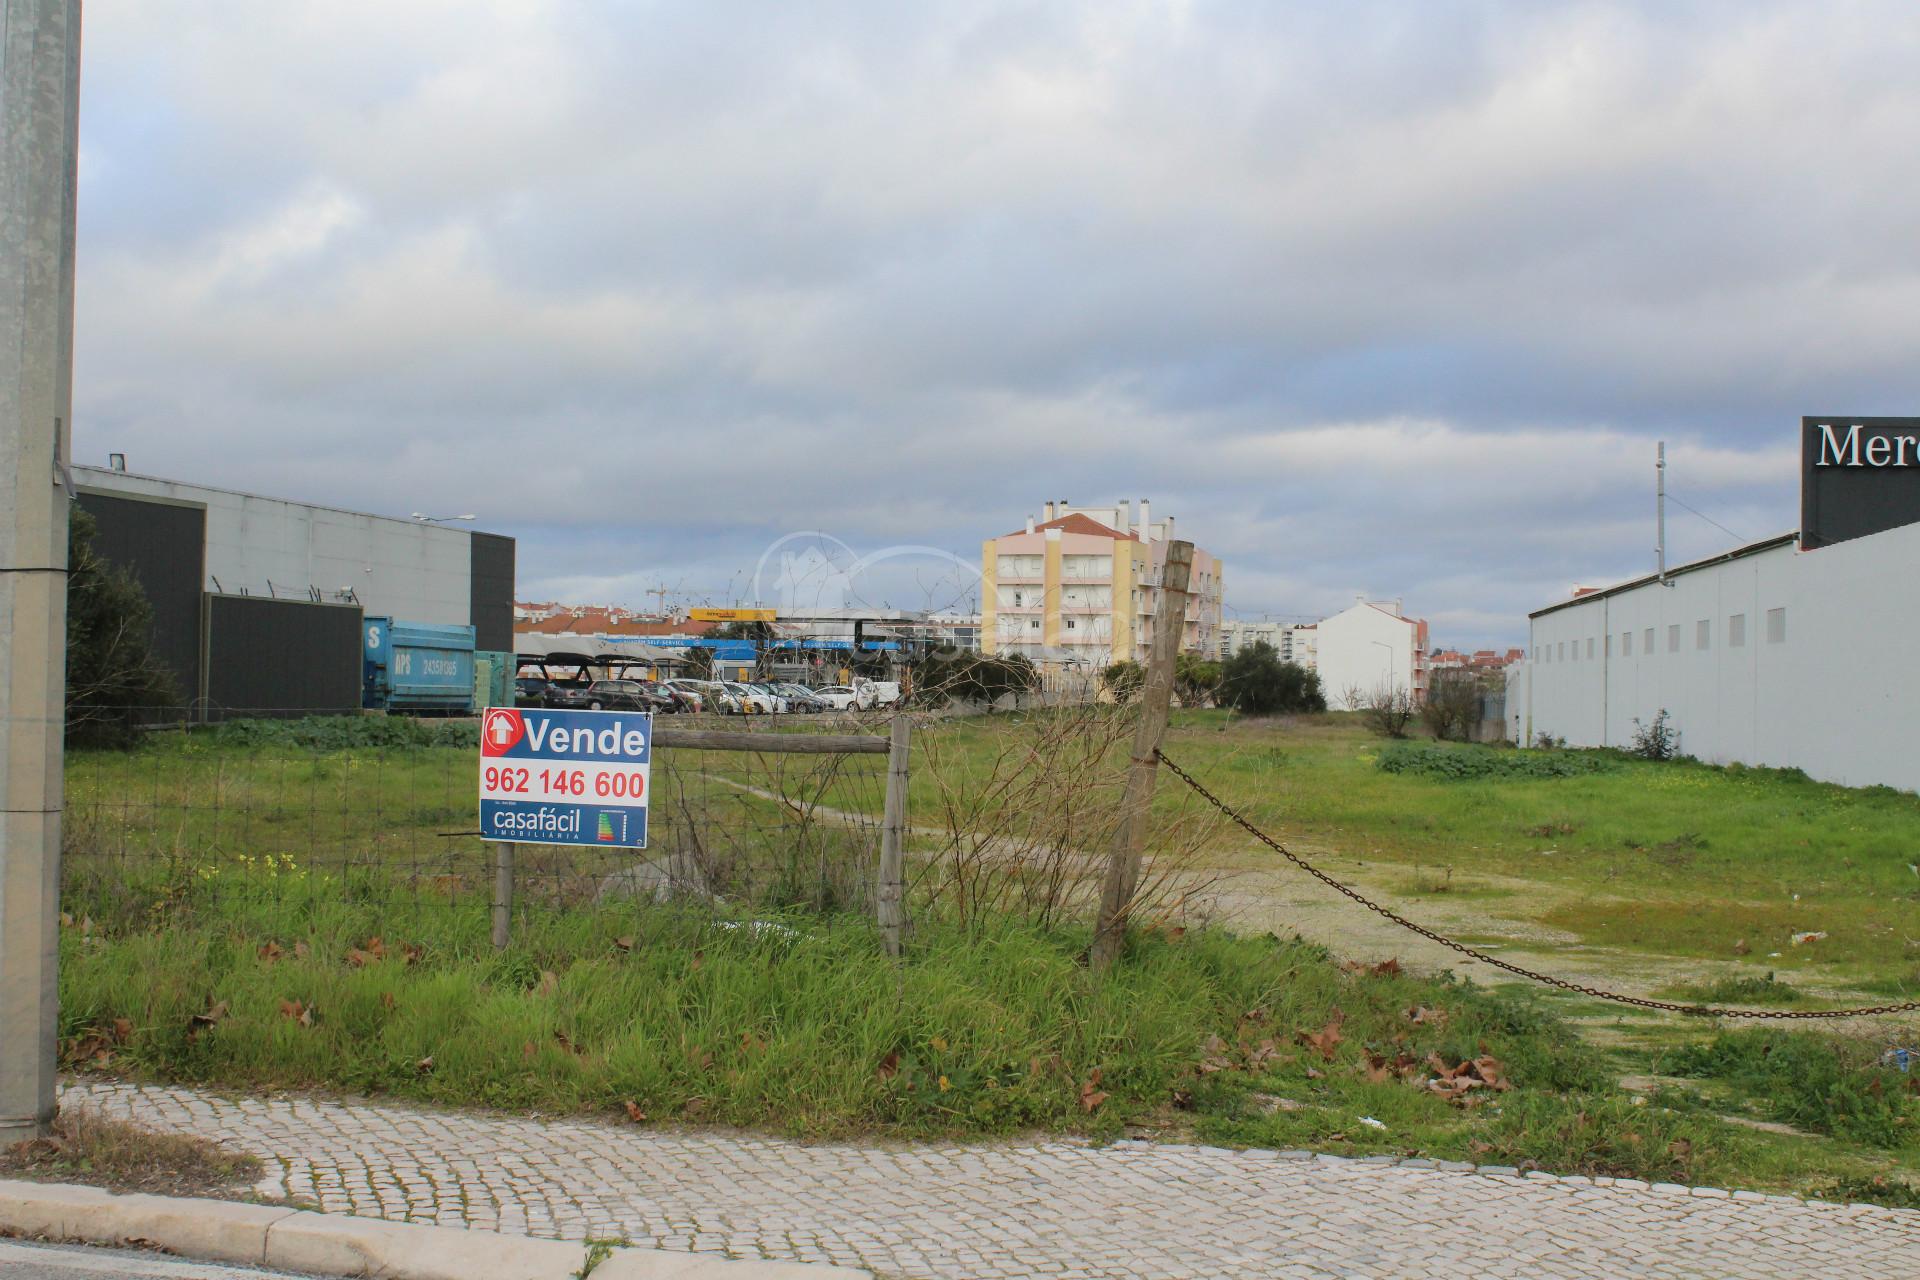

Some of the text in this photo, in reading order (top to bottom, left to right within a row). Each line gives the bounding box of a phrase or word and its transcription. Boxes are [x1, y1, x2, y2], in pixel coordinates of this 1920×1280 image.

[1816, 424, 1920, 467] Mer
[368, 626, 380, 648] S
[523, 717, 645, 756] Vende
[485, 766, 644, 798] 962 146 600
[493, 806, 581, 832] casafácil
